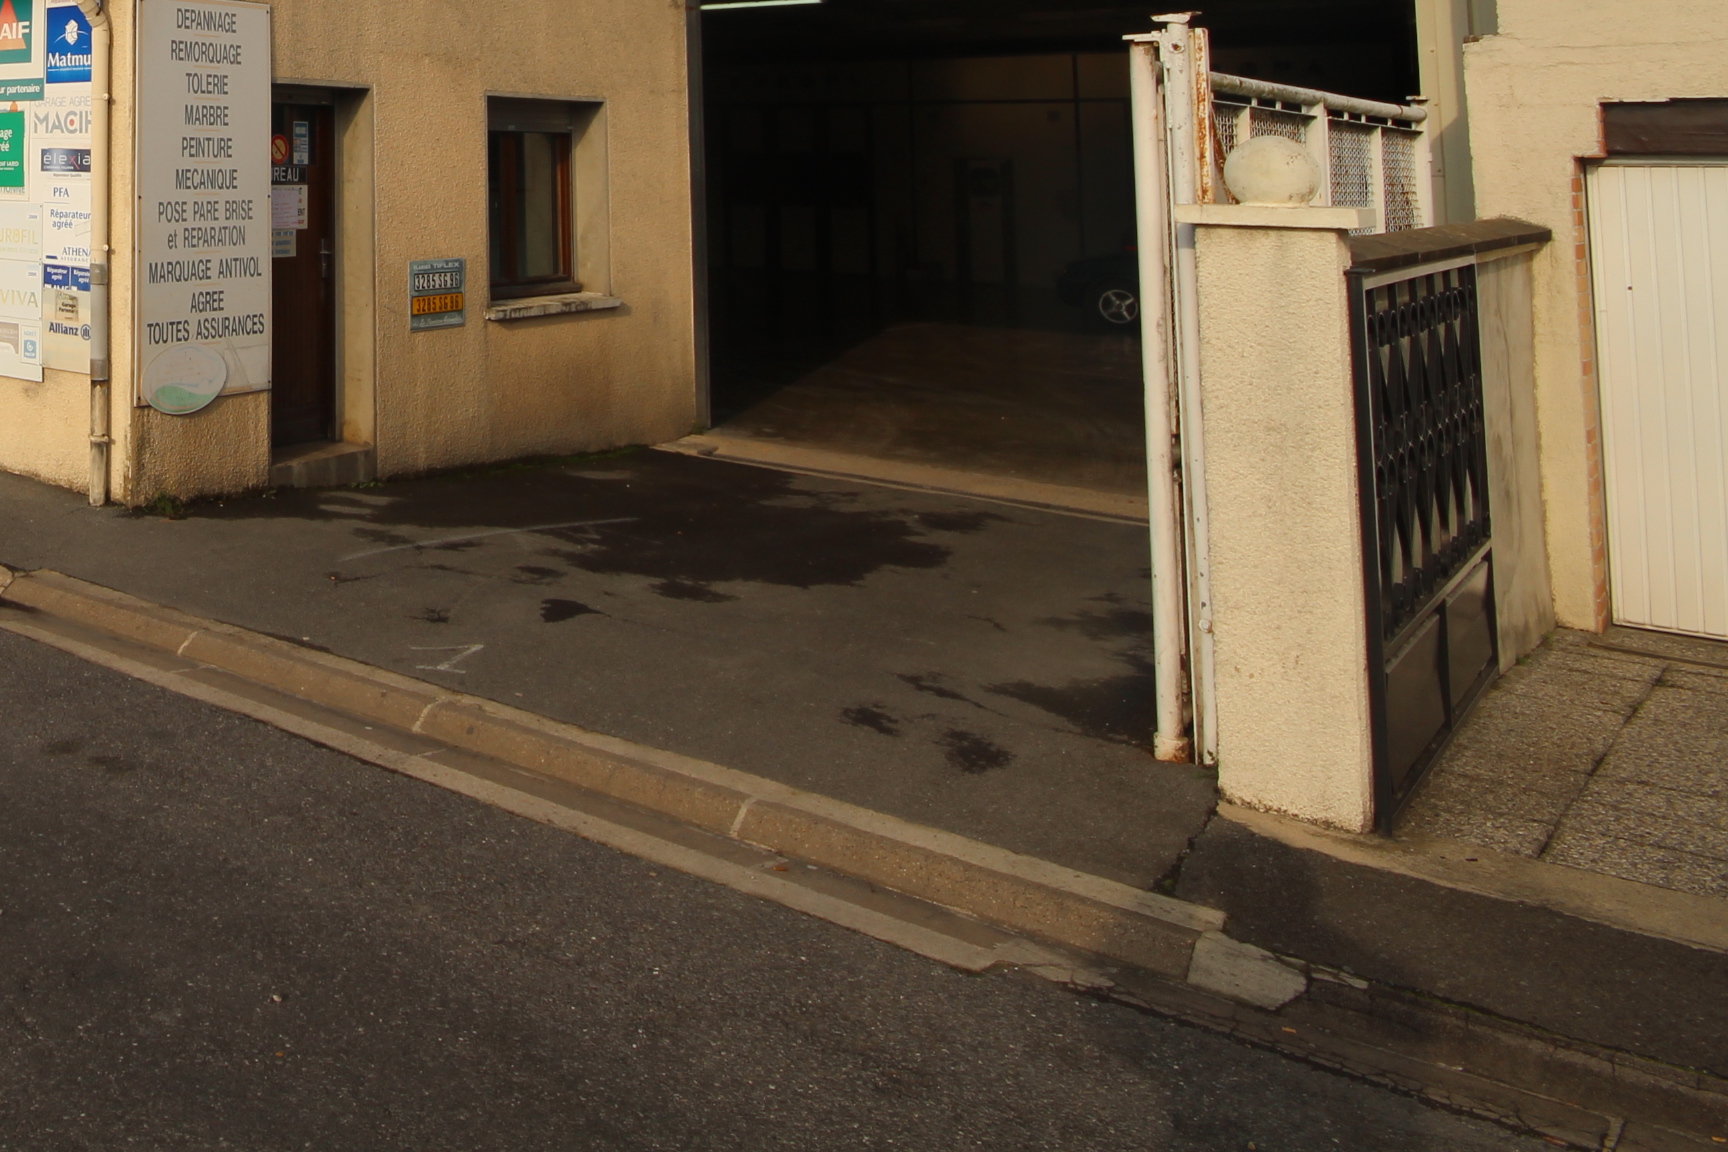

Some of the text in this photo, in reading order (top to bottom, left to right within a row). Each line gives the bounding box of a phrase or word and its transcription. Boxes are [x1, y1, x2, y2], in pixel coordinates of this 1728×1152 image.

[176, 8, 237, 34] DEPANNAGE
[47, 52, 91, 68] Matmu
[170, 39, 242, 65] REMORQUAGE
[6, 83, 41, 96] partenaire
[185, 72, 229, 95] TOLERIE
[184, 104, 229, 126] MARBRE
[181, 136, 233, 158] PEINTURE
[175, 168, 238, 190] MECANIQUE
[271, 167, 300, 182] REAU
[53, 187, 70, 198] PFA
[50, 208, 92, 220] Réparateur
[158, 201, 188, 223] POSE
[193, 200, 220, 222] PARE
[224, 199, 254, 221] BRISE
[52, 219, 73, 230] agréé
[167, 229, 178, 250] et
[183, 225, 246, 249] REPARATION
[148, 256, 262, 284] MARQUAGE ANTIVOL
[415, 272, 459, 290] 3285 SG 96
[190, 290, 225, 313] AGREE
[416, 295, 459, 313] 3285 SG 96
[48, 322, 79, 337] Allianz
[146, 313, 265, 346] TOUTES ASSURANCES
